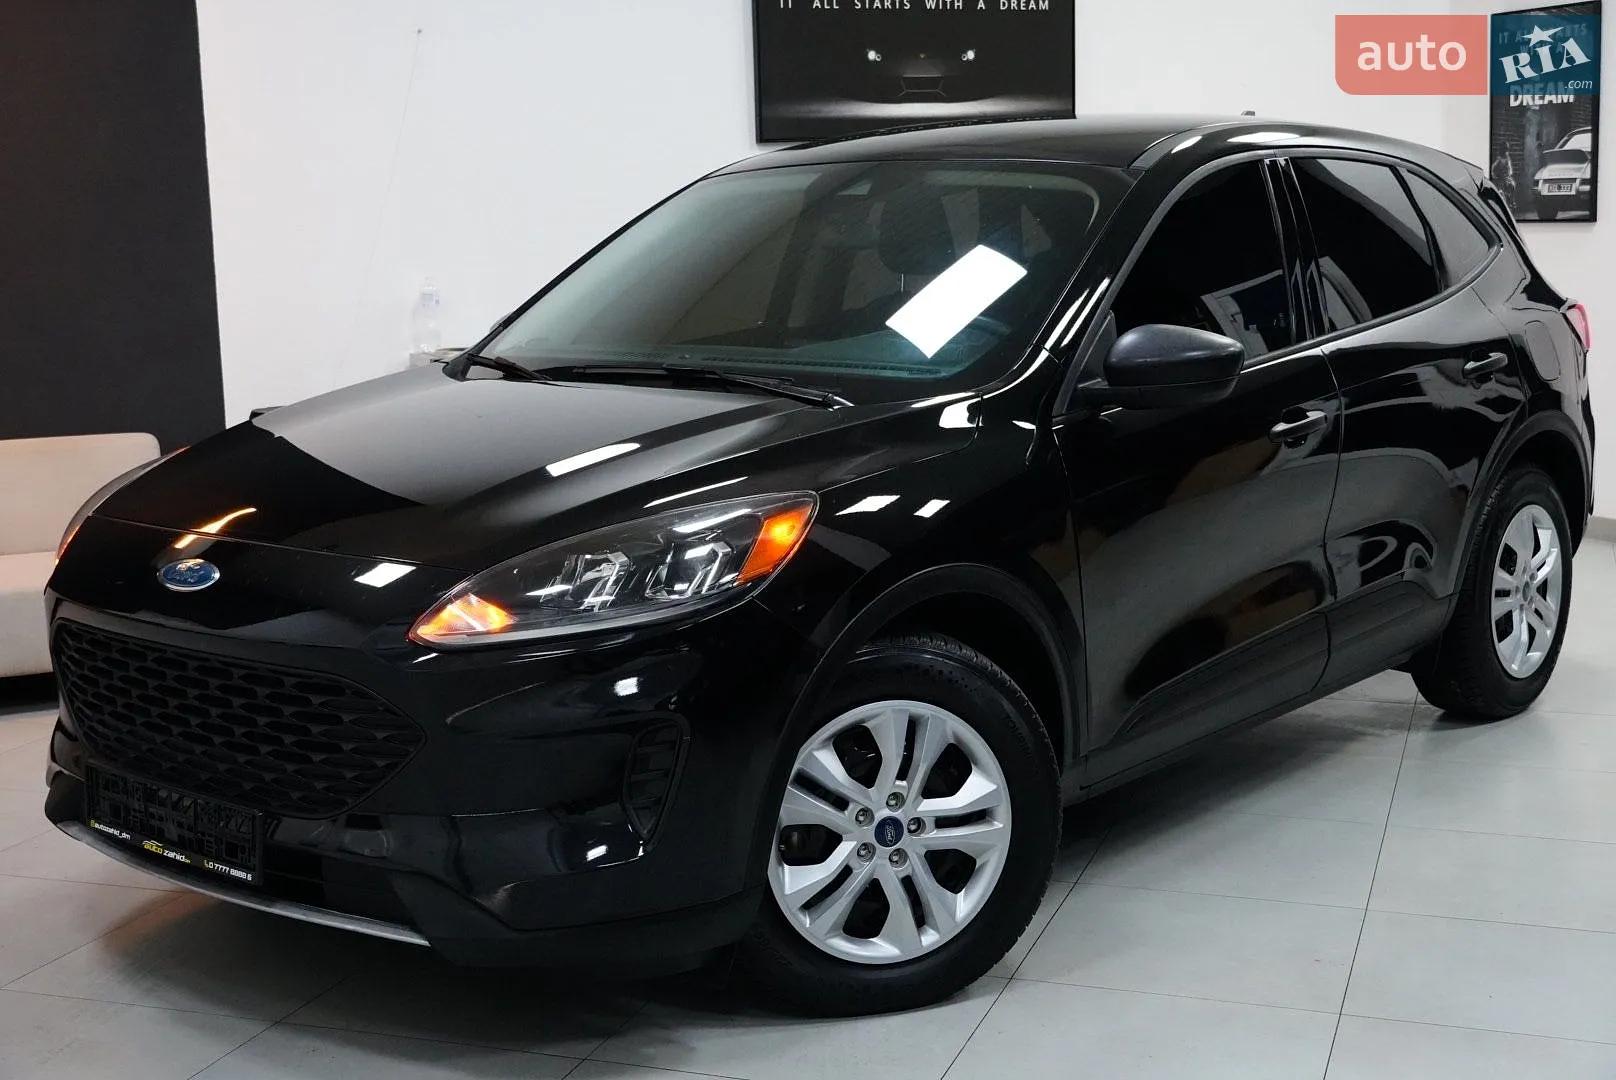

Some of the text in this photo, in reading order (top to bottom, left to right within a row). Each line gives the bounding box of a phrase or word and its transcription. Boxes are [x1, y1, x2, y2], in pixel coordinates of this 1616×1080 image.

[812, 0, 840, 9] ALL
[854, 0, 911, 10] STARTS
[925, 0, 963, 10] WITH
[977, 0, 986, 10] A
[1000, 0, 1049, 10] DREAM
[1509, 81, 1574, 107] DREAM
[163, 849, 186, 862] zahid
[214, 863, 230, 874] 7777
